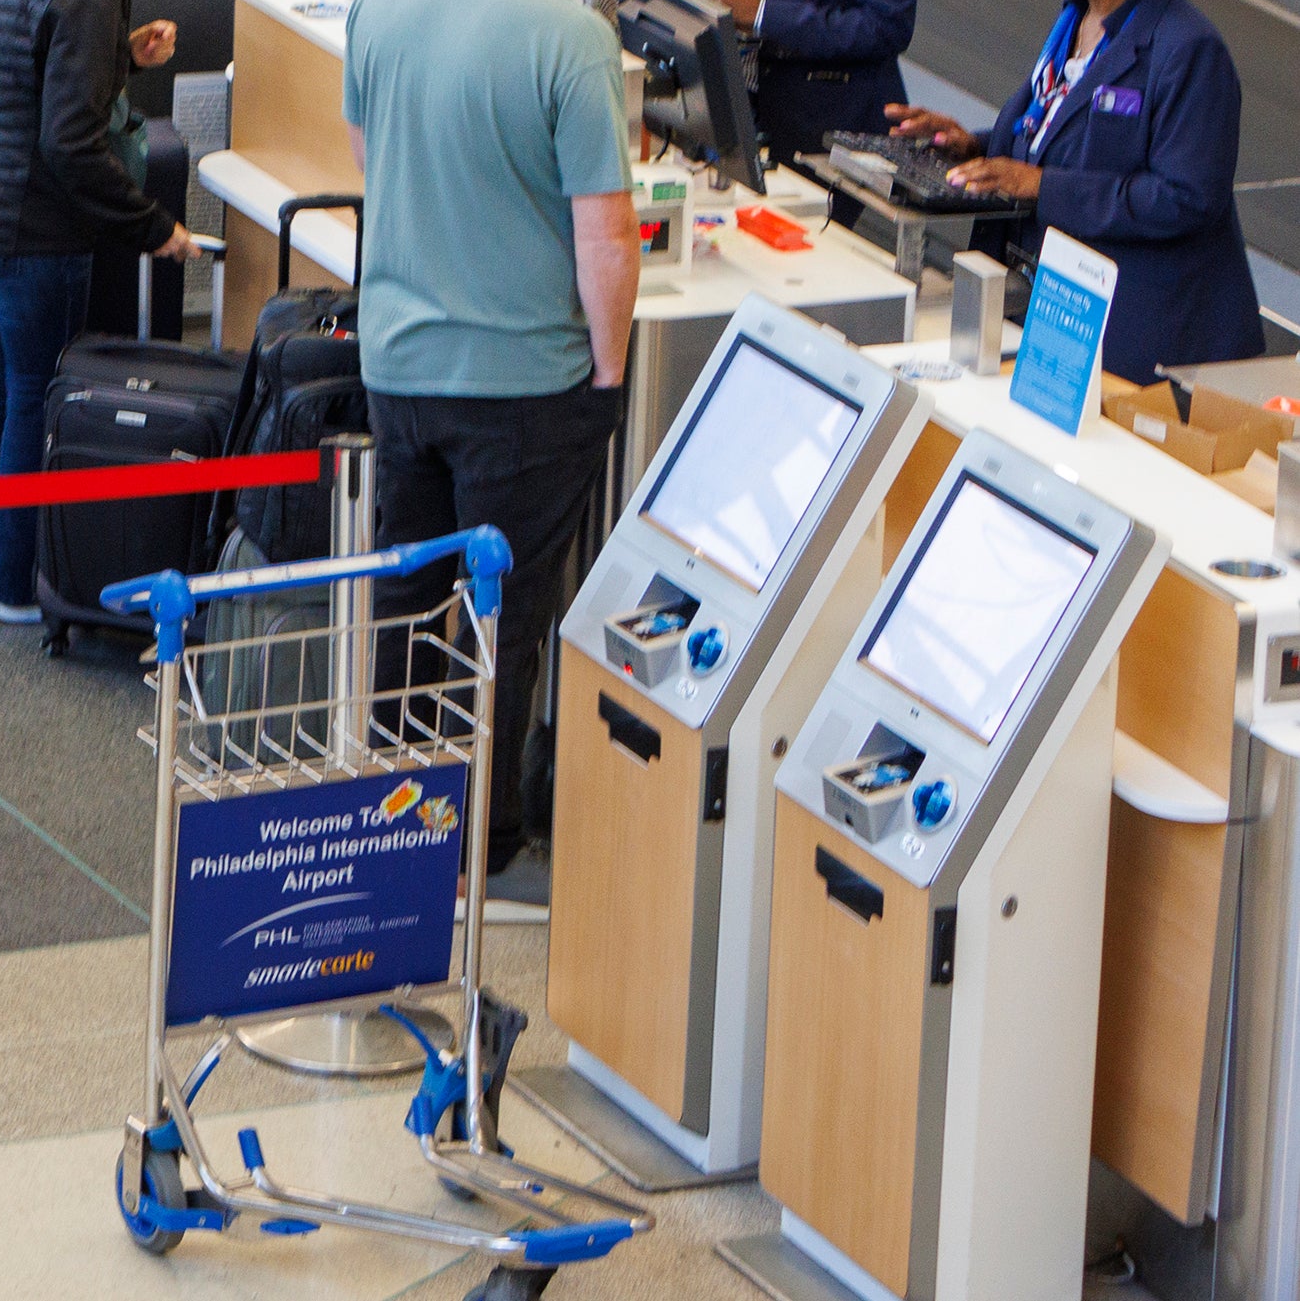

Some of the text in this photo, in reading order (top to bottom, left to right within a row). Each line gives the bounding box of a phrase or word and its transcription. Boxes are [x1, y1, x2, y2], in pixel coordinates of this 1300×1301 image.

[260, 811, 353, 843] Welcome
[190, 826, 450, 881] Philadelphia International
[282, 863, 355, 895] Airport
[254, 926, 301, 949] PHL
